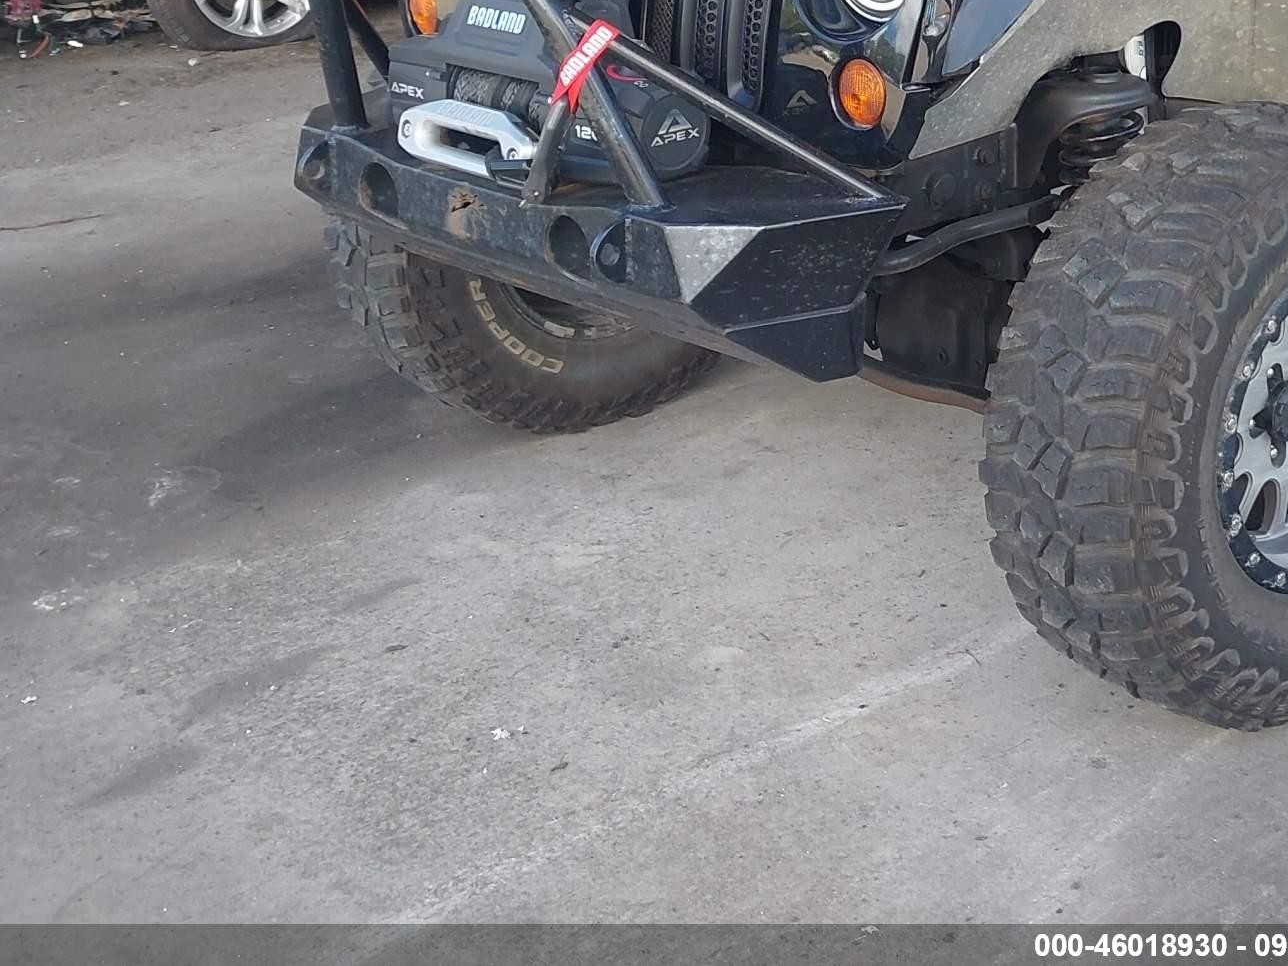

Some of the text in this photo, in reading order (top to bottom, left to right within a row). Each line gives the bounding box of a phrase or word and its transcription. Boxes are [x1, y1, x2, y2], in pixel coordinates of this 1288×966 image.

[466, 4, 527, 34] BADLAND
[560, 25, 613, 87] BADLAND
[391, 81, 425, 100] APEX
[650, 127, 700, 148] APEX
